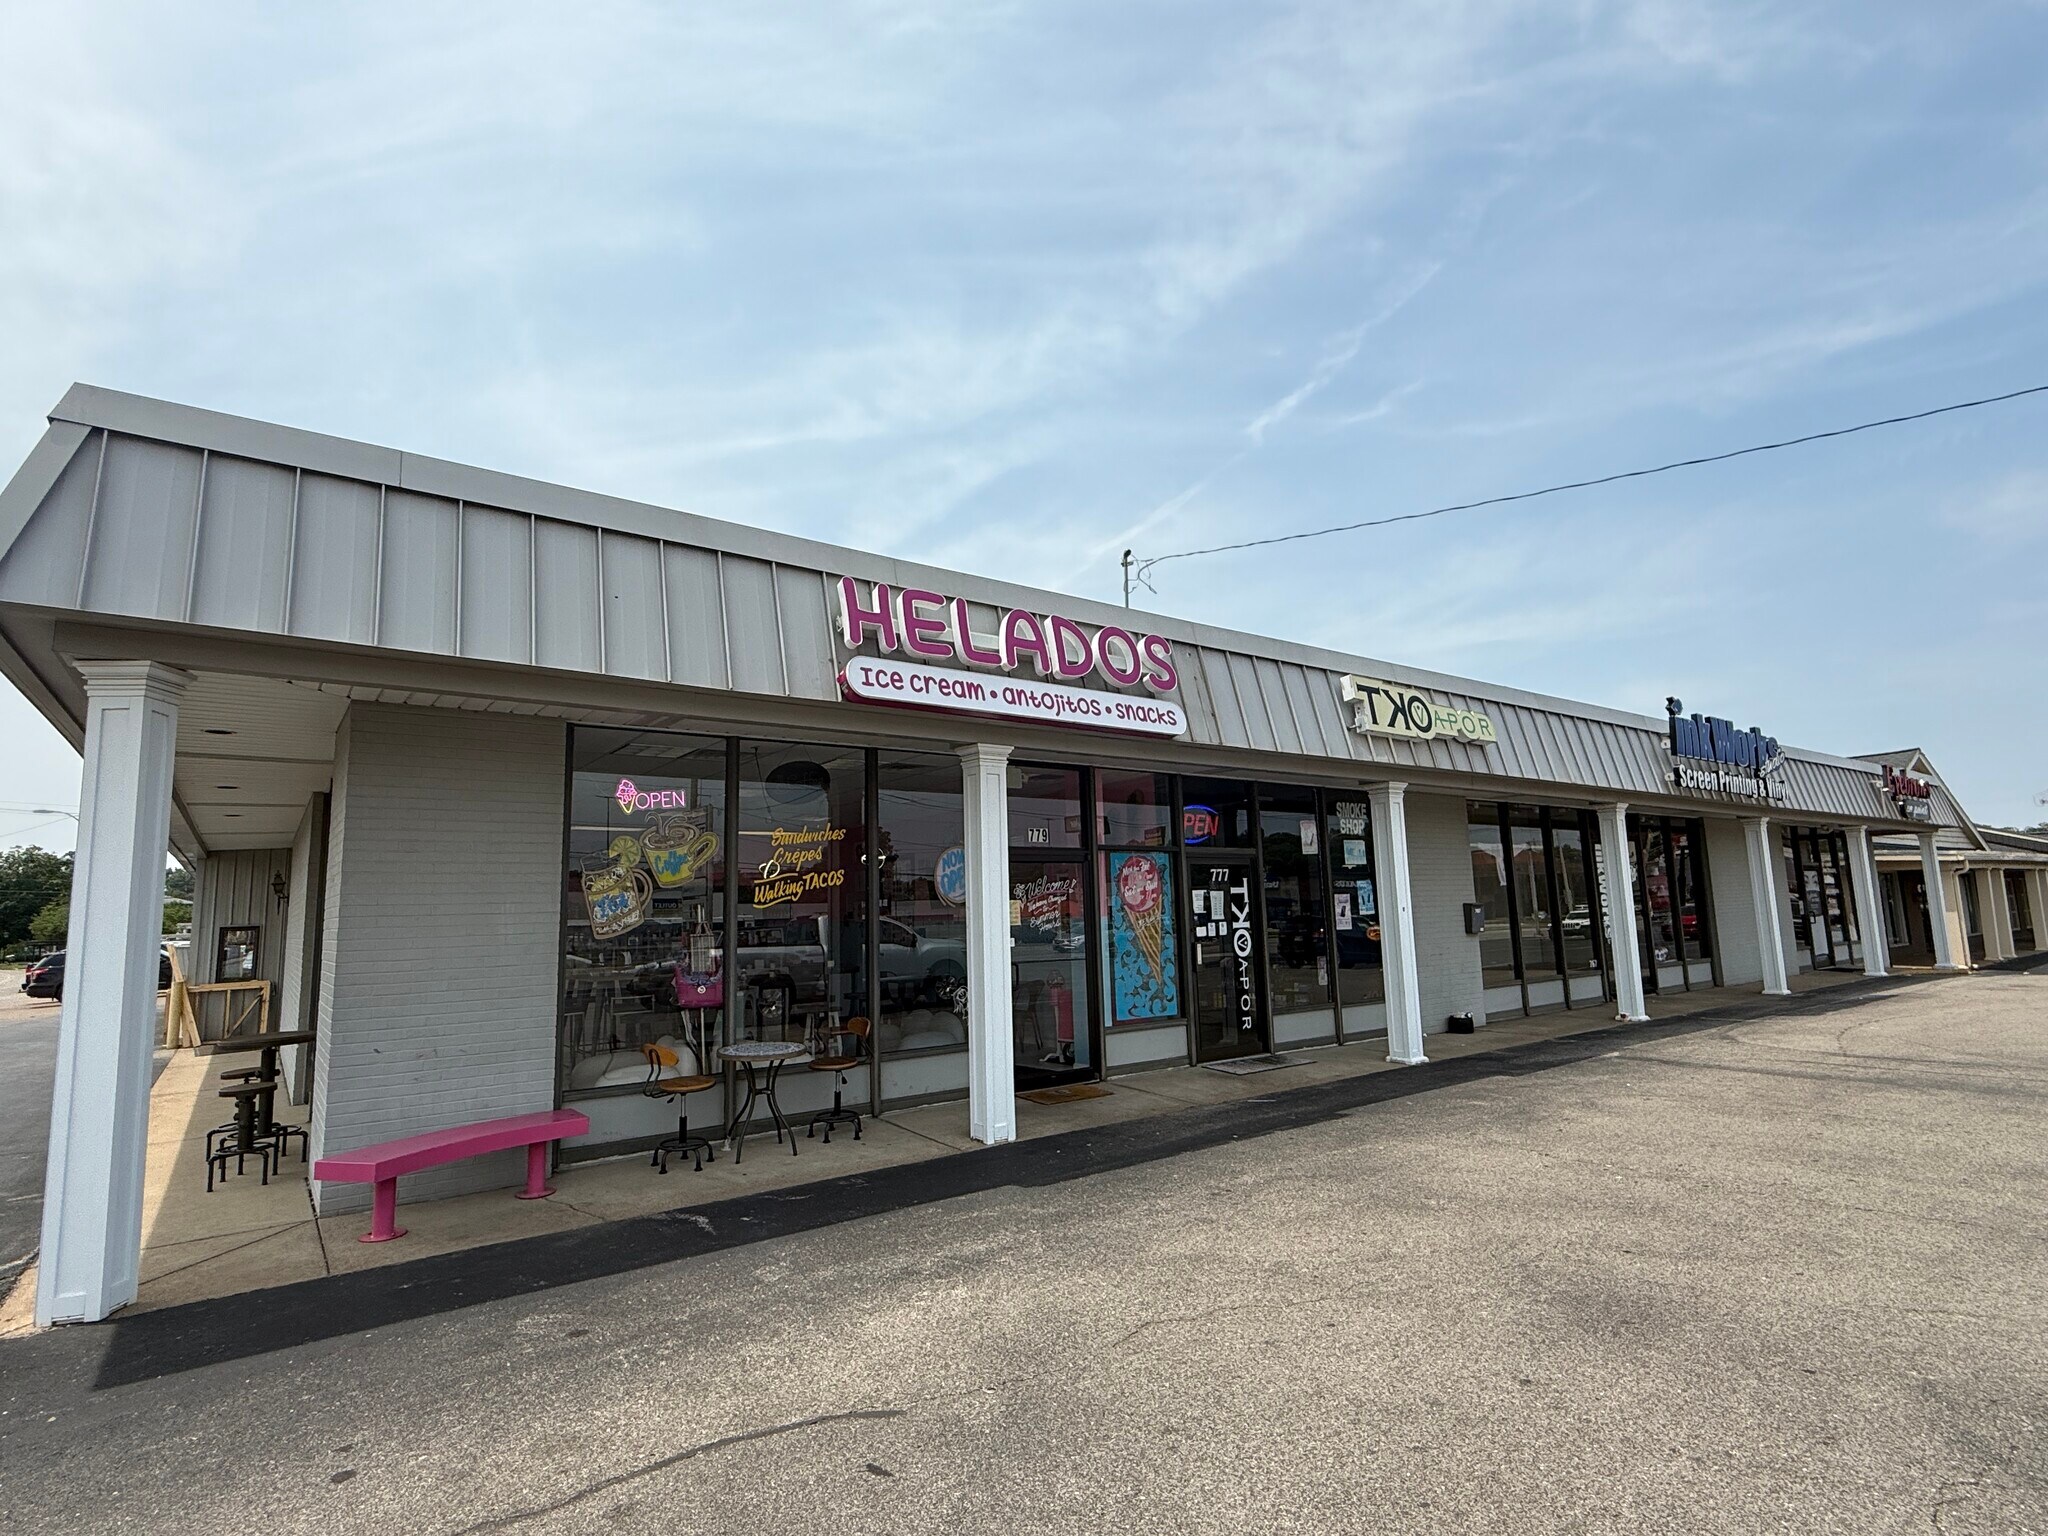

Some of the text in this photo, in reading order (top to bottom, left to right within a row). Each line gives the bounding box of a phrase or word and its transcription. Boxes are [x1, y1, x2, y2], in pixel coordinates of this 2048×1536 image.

[839, 576, 1177, 692] HELADOS
[860, 666, 1178, 726] Ice cream antojitos snacks
[1679, 764, 1718, 791] Screen
[1719, 770, 1758, 798] Printing
[1766, 777, 1789, 801] Vinyl
[635, 790, 686, 810] OPEN
[1336, 801, 1367, 820] SMOKE
[771, 823, 846, 846] Sandwiches
[1029, 828, 1048, 842] 779
[1183, 813, 1219, 836] PEN
[1340, 820, 1365, 835] SHOP
[754, 869, 844, 902] Walking TACOS
[1210, 868, 1229, 882] 777
